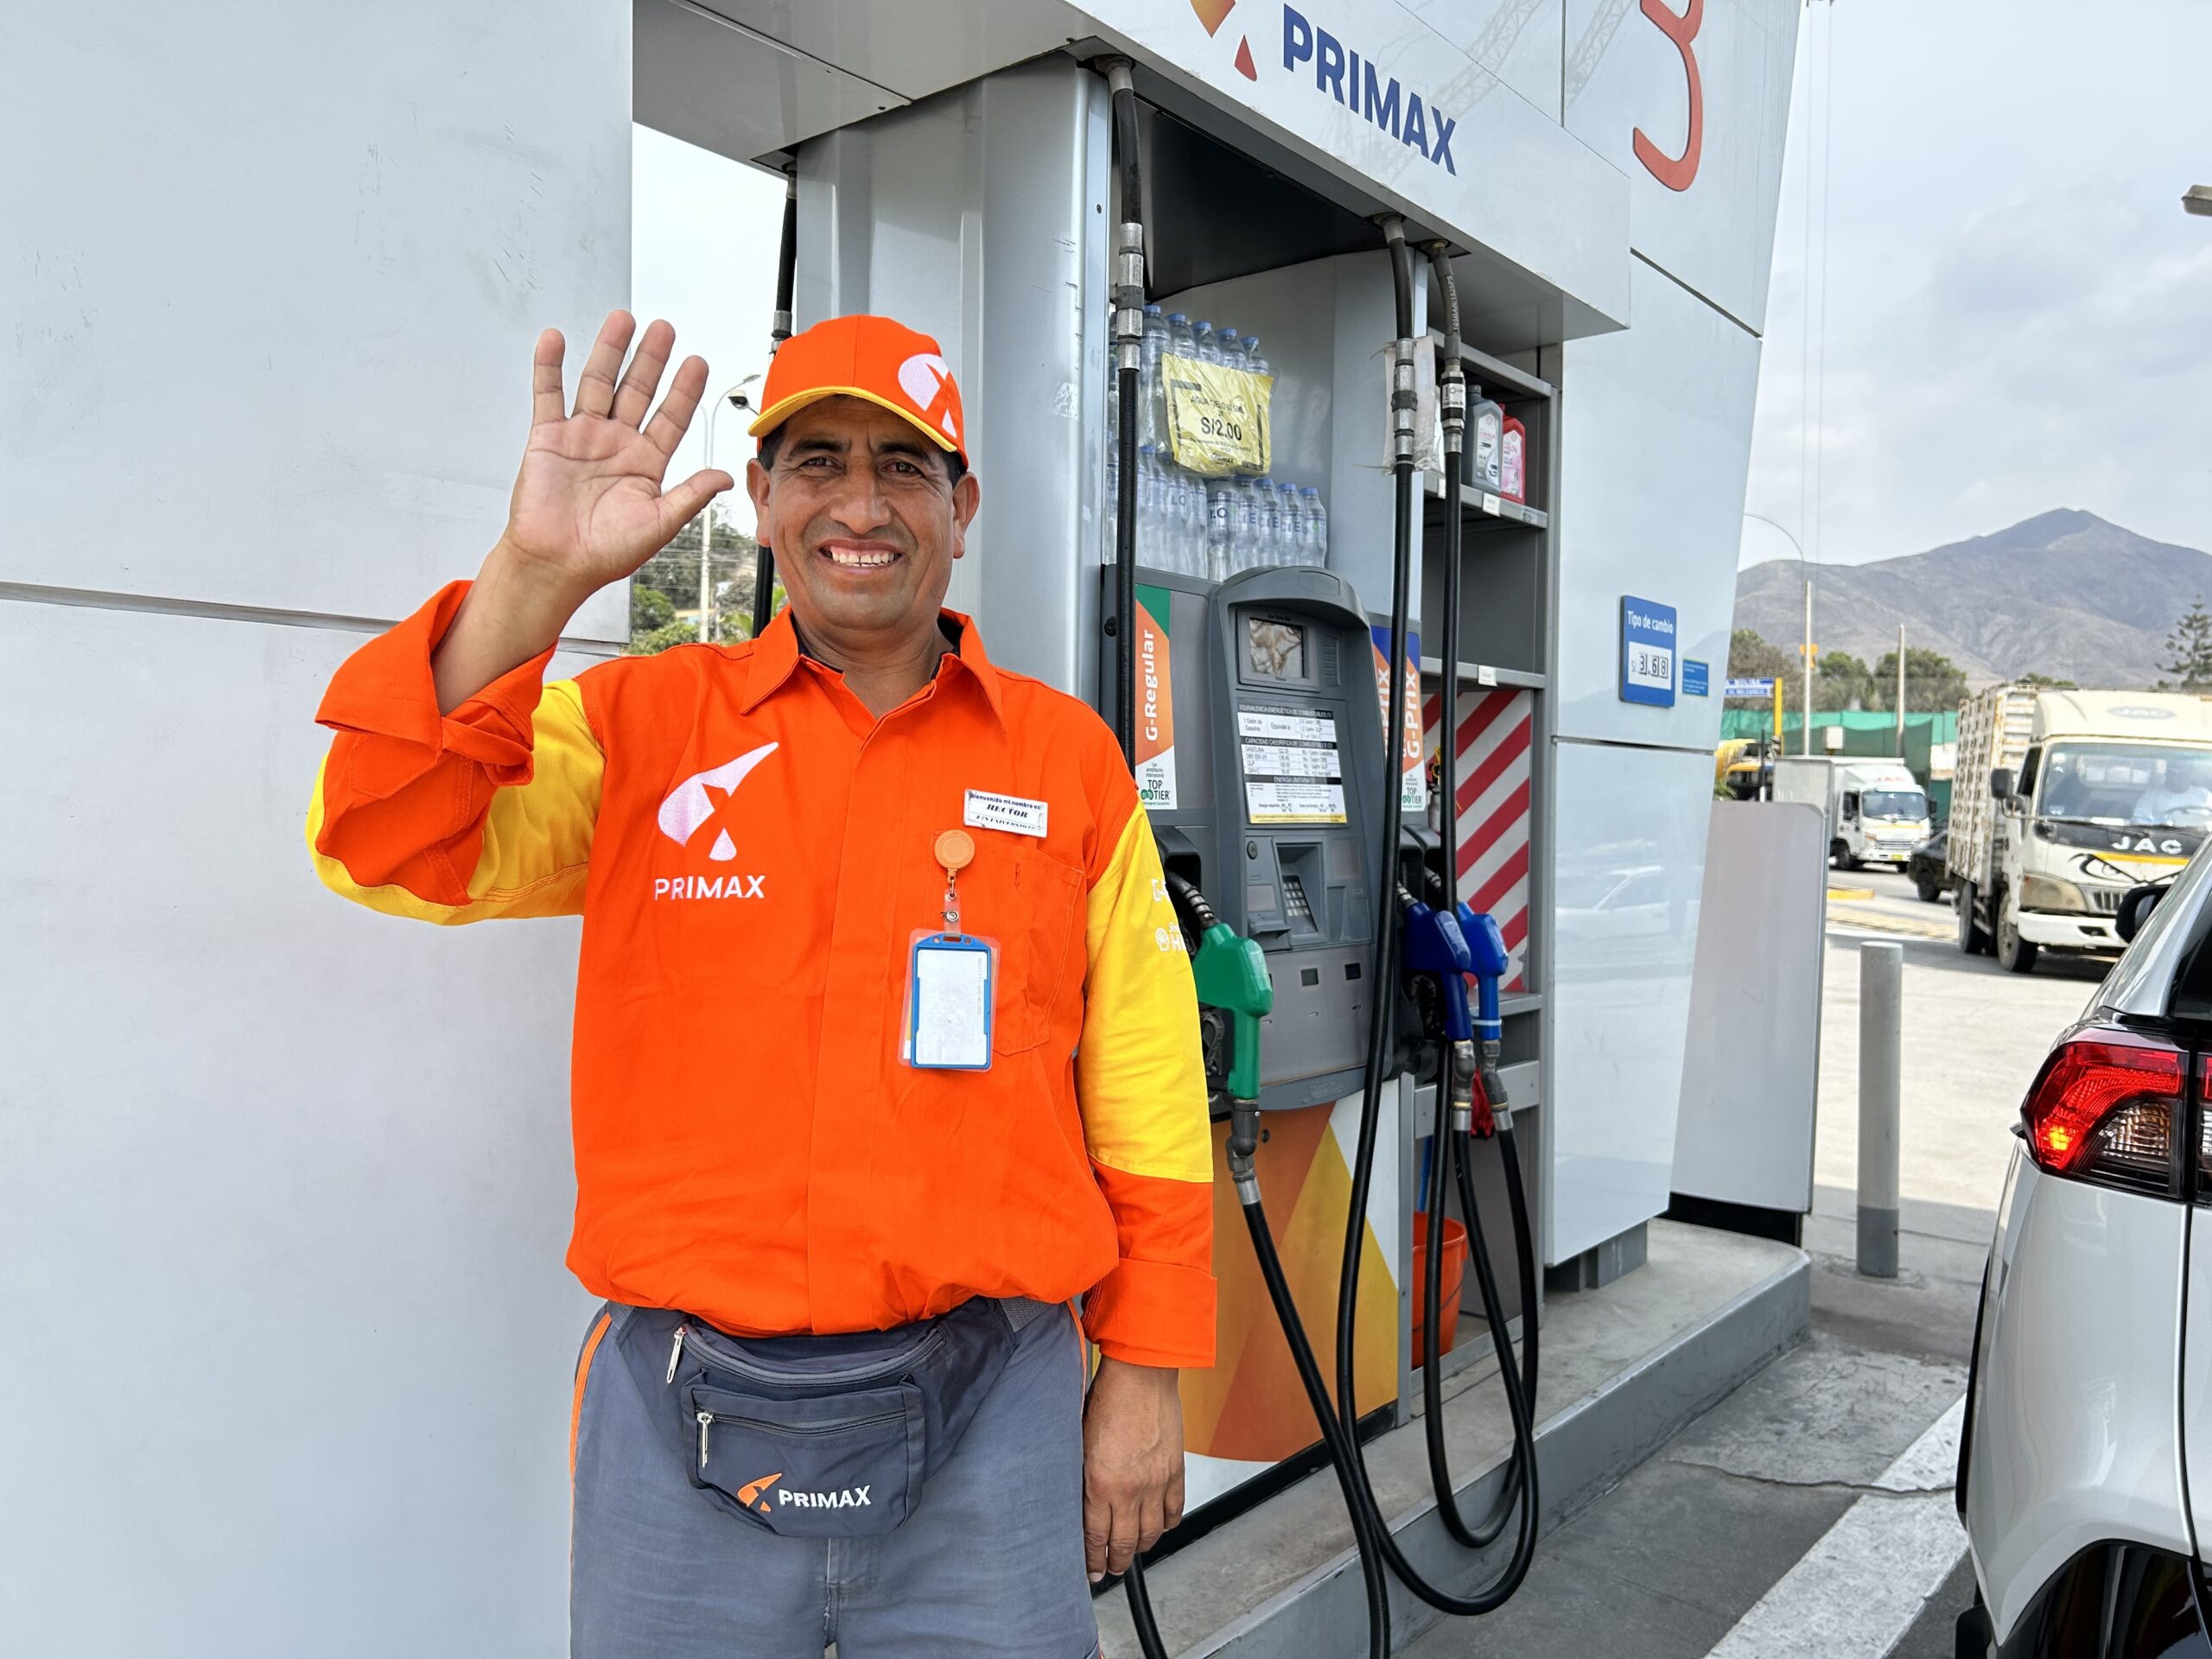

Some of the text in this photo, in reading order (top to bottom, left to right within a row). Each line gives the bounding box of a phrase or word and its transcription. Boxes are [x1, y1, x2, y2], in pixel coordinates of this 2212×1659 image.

[1283, 3, 1457, 177] PRIMAX
[1191, 396, 1210, 406] AGUA
[1201, 416, 1243, 441] S/2.00
[1628, 610, 1674, 634] Tipo de cambio
[1141, 629, 1159, 741] G-Regular
[1147, 779, 1163, 790] TOP
[1154, 790, 1170, 800] TIER
[1011, 800, 1033, 809] nombre
[2112, 836, 2183, 855] JAC
[654, 874, 766, 901] PRIMAX
[779, 1484, 872, 1509] PRIMAX
